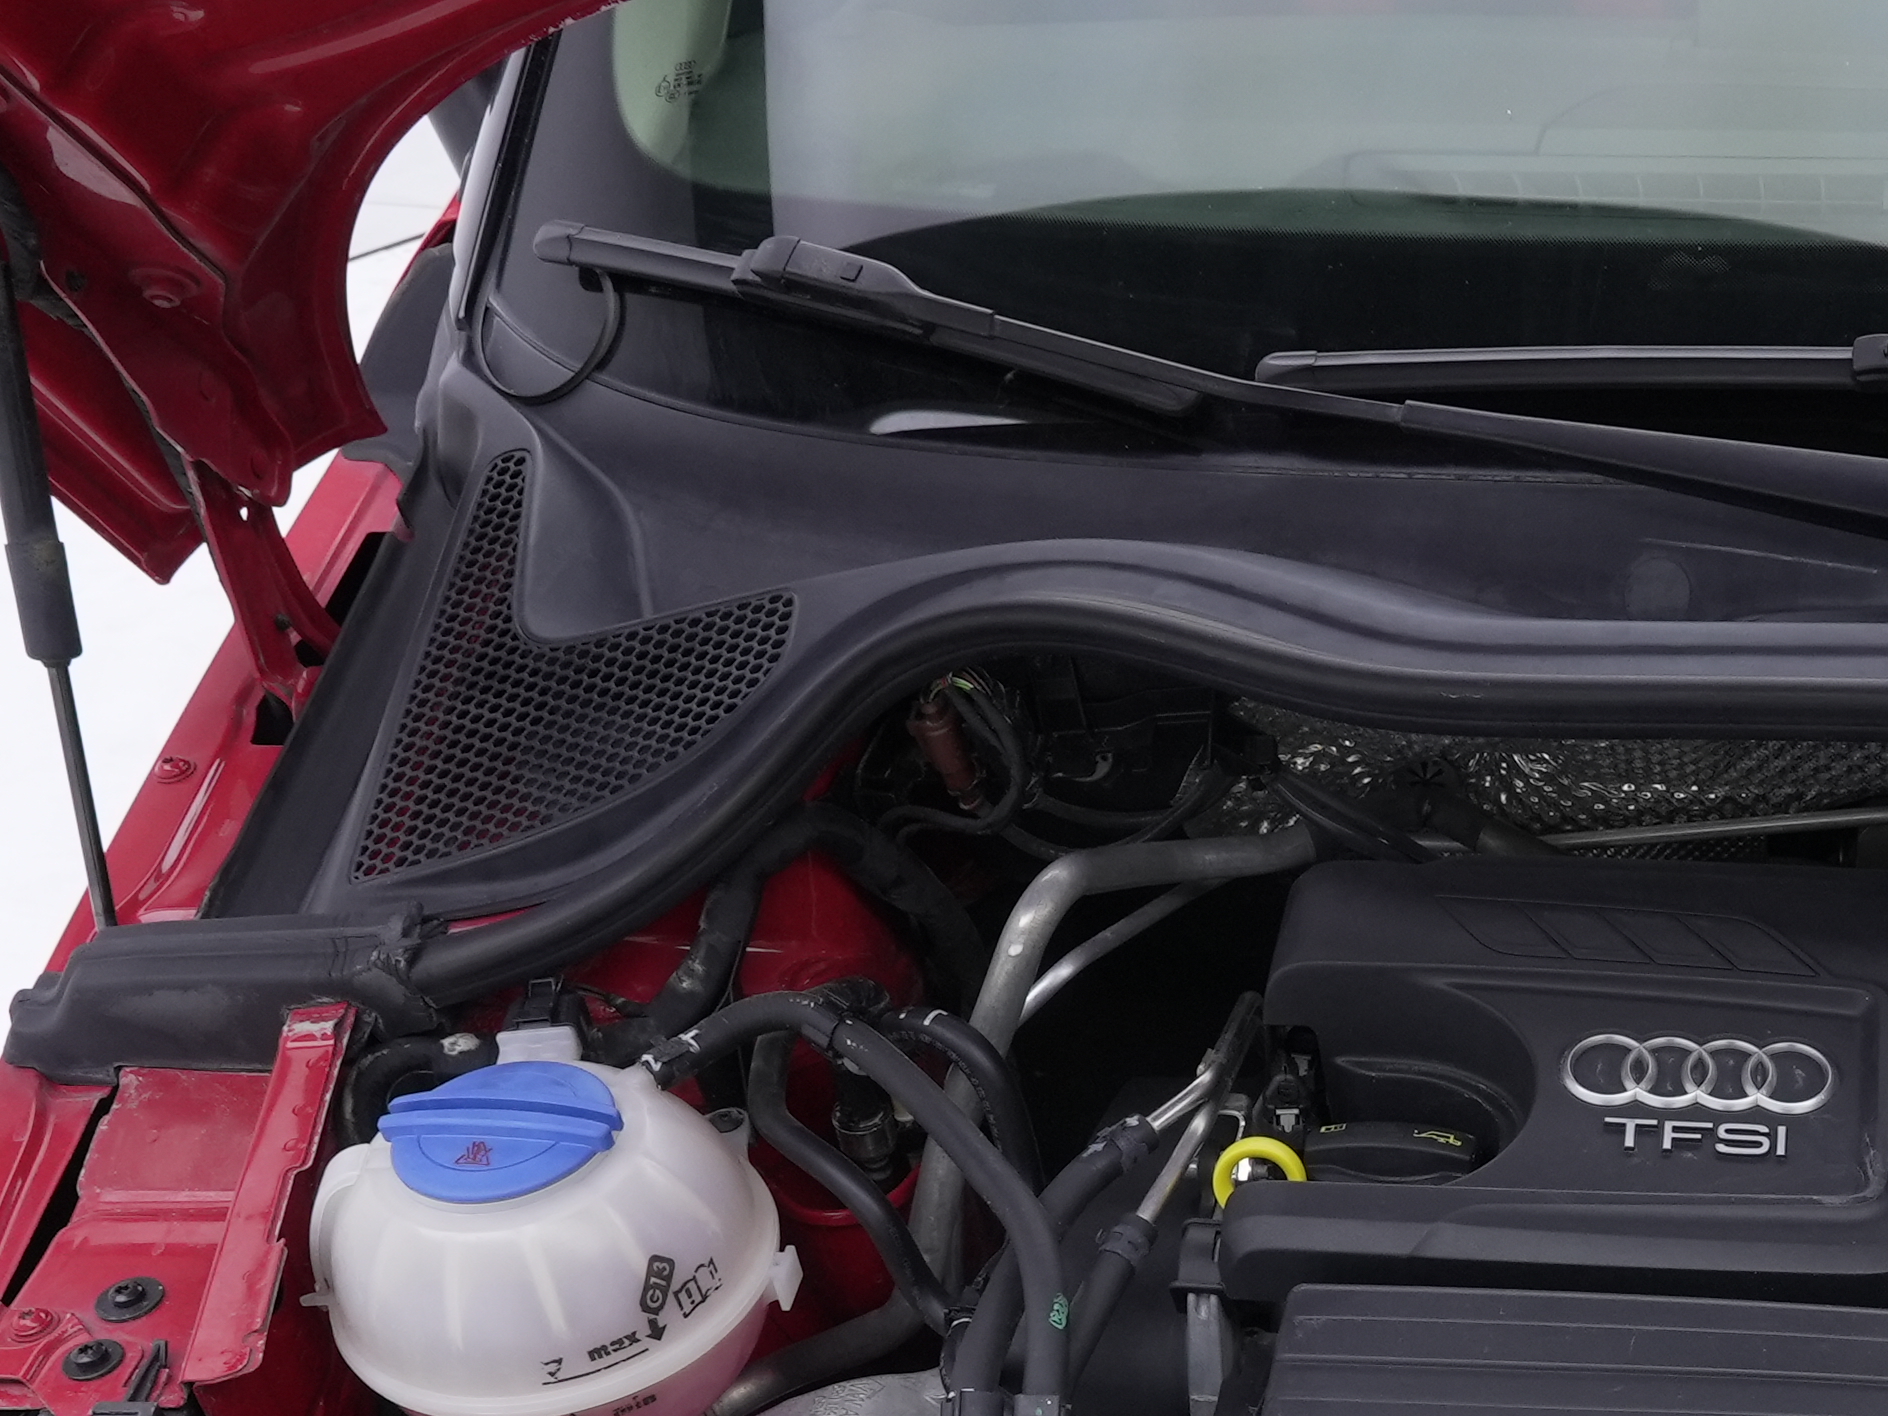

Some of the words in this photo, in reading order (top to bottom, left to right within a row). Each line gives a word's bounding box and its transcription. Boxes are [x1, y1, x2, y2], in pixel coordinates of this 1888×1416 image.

[1604, 1116, 1788, 1157] TFSI
[645, 1261, 670, 1309] G13
[587, 1330, 643, 1363] max
